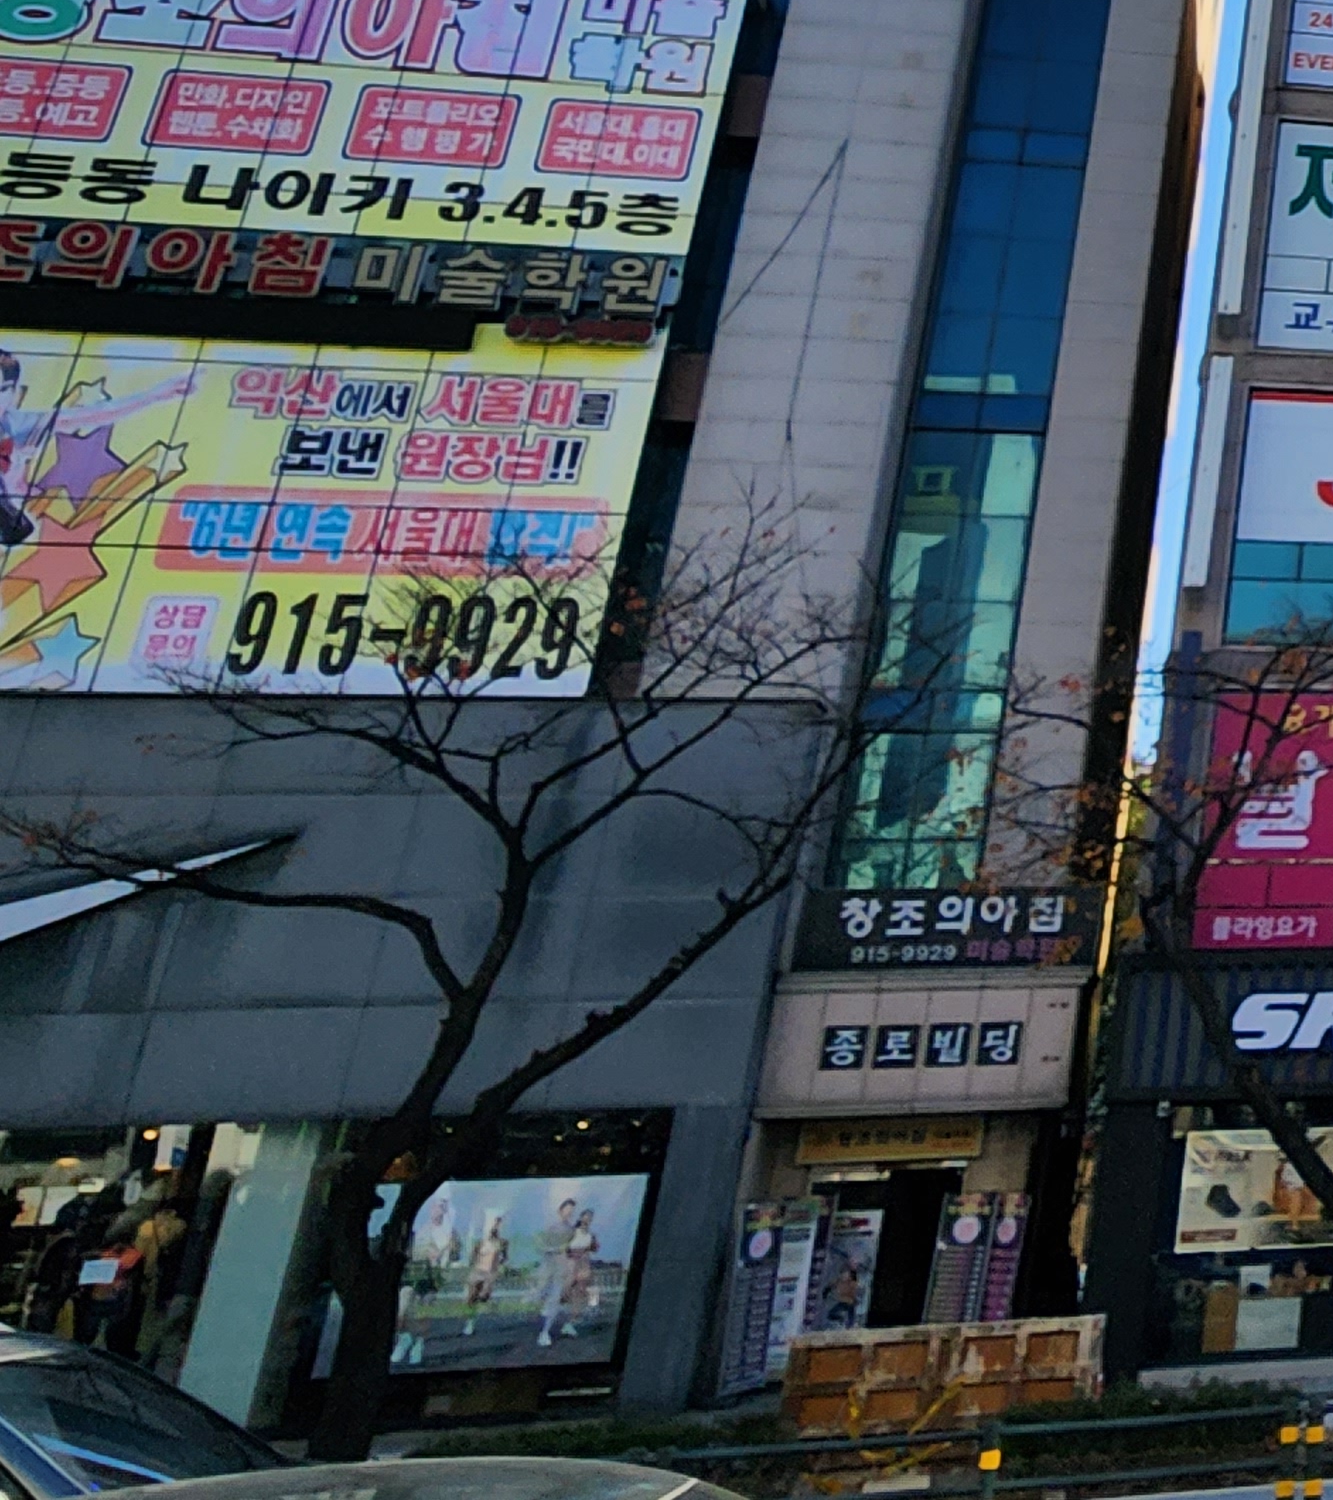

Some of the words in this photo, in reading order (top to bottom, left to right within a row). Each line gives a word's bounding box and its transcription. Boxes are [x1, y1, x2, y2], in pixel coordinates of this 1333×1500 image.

[1310, 12, 1333, 29] 24
[370, 96, 501, 128] 포트폴리오
[182, 164, 413, 220] 나이키
[437, 181, 679, 237] 3.4.5층
[352, 245, 668, 320] 미술학원
[232, 368, 412, 424] 익산에서
[278, 428, 384, 482] 보낸
[398, 428, 584, 485] 원장님!!
[269, 500, 353, 566] 연속
[357, 505, 475, 567] 서울대
[155, 603, 206, 630] 상담
[228, 590, 580, 680] 915-9929
[145, 633, 196, 660] 문의
[850, 945, 957, 963] 915-9929
[824, 1024, 1021, 1069] 종로빌딩
